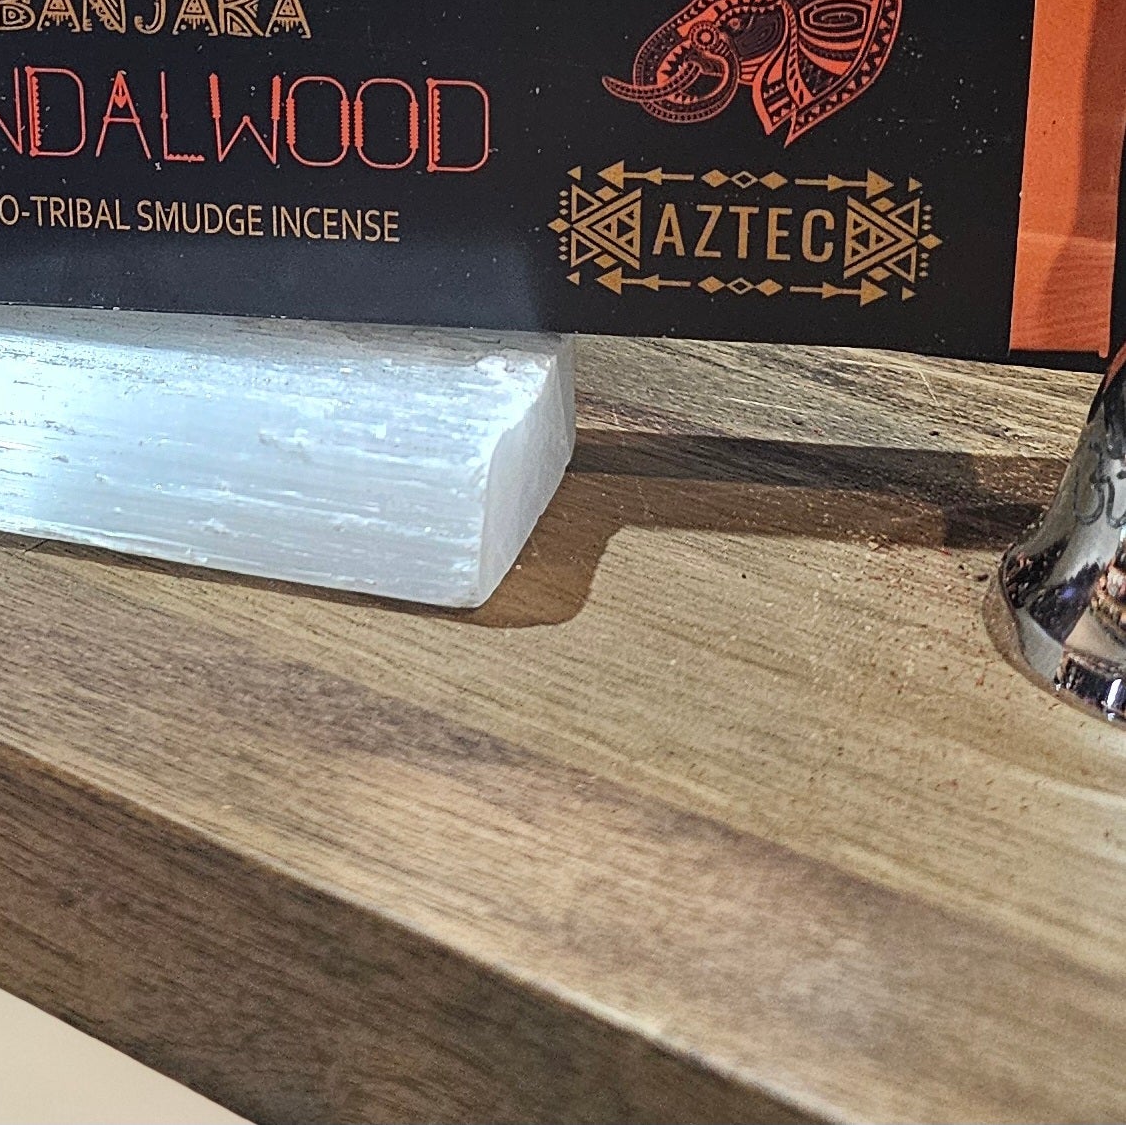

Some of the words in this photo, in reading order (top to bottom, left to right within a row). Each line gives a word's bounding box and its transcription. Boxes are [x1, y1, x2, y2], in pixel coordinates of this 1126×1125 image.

[136, 199, 265, 237] SMUDGE
[271, 206, 401, 243] INCENSE
[652, 203, 835, 264] AZTEC
